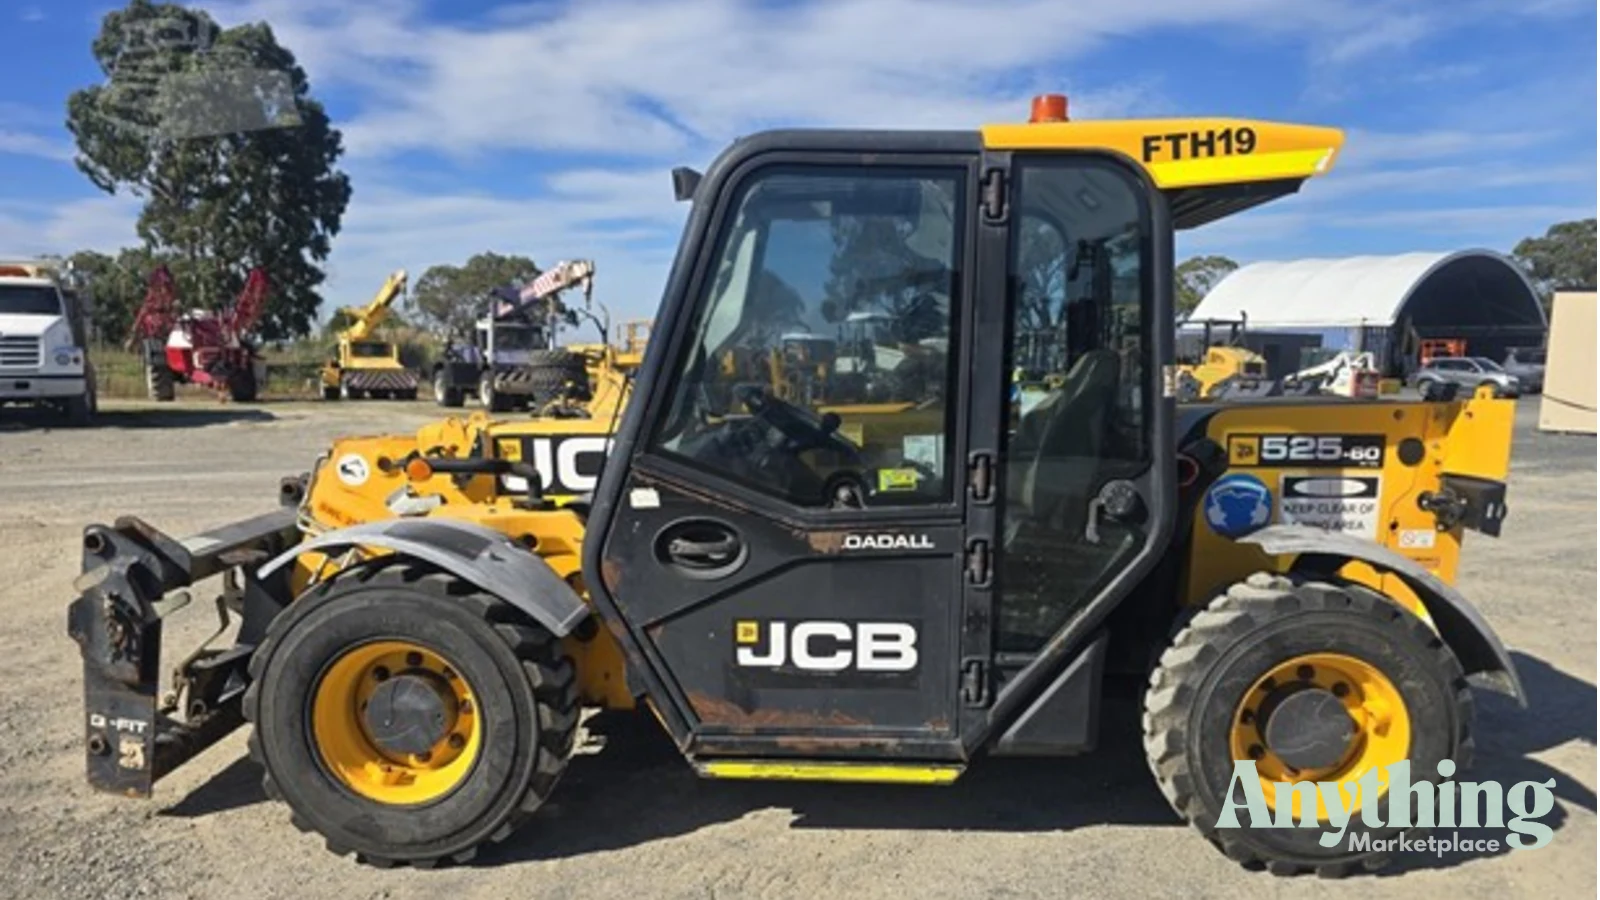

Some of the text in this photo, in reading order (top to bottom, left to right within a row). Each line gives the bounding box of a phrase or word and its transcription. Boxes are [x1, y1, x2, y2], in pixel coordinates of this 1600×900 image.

[1142, 127, 1257, 162] FTH19
[1284, 503, 1375, 514] KEEP CLEAR OF
[1331, 520, 1366, 533] AREA
[841, 534, 935, 549] OADALL
[736, 621, 918, 671] JCB
